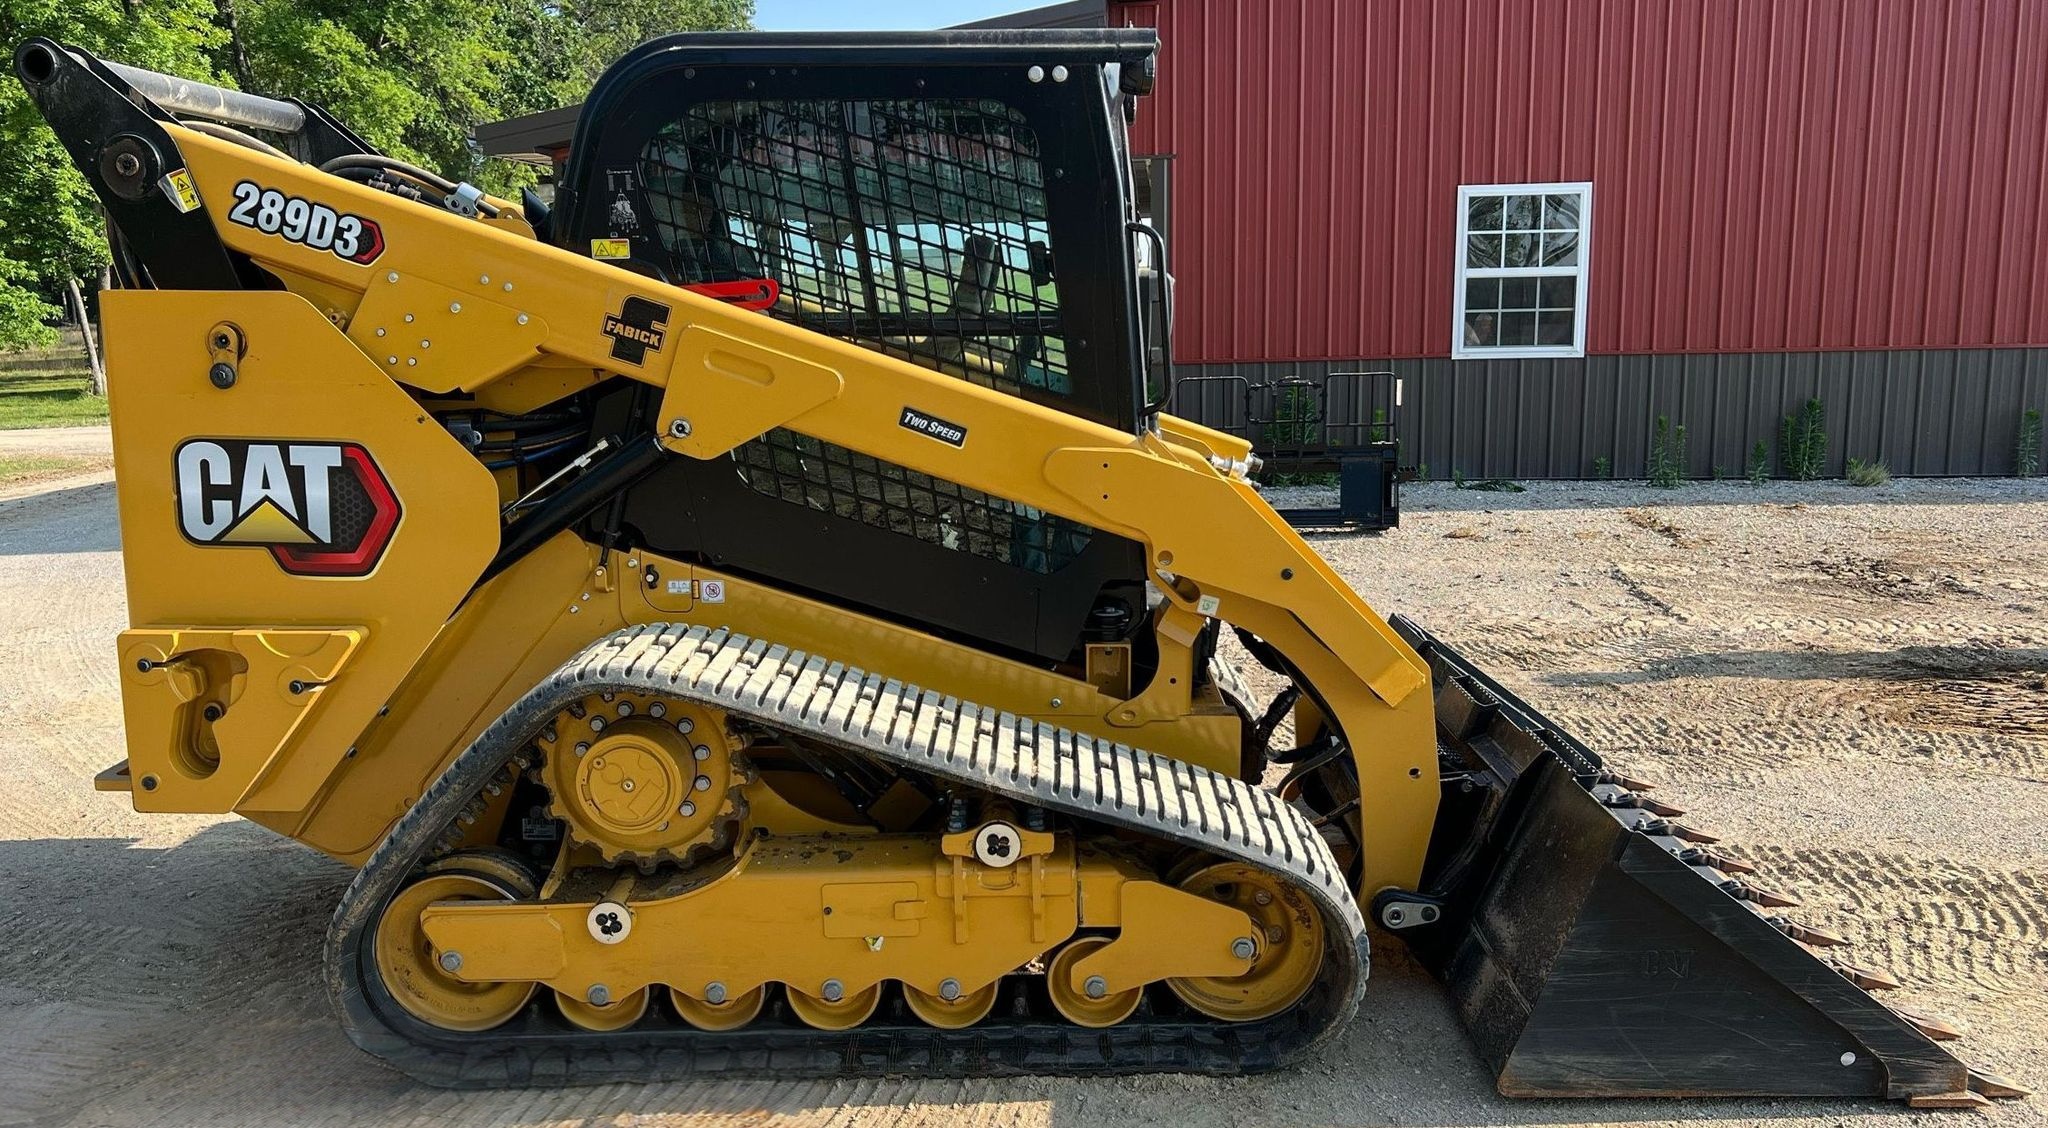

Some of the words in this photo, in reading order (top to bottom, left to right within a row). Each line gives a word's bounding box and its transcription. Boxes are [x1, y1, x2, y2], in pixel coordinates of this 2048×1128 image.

[231, 182, 362, 257] 289D3
[606, 320, 660, 346] FABICK
[178, 441, 342, 543] CAT
